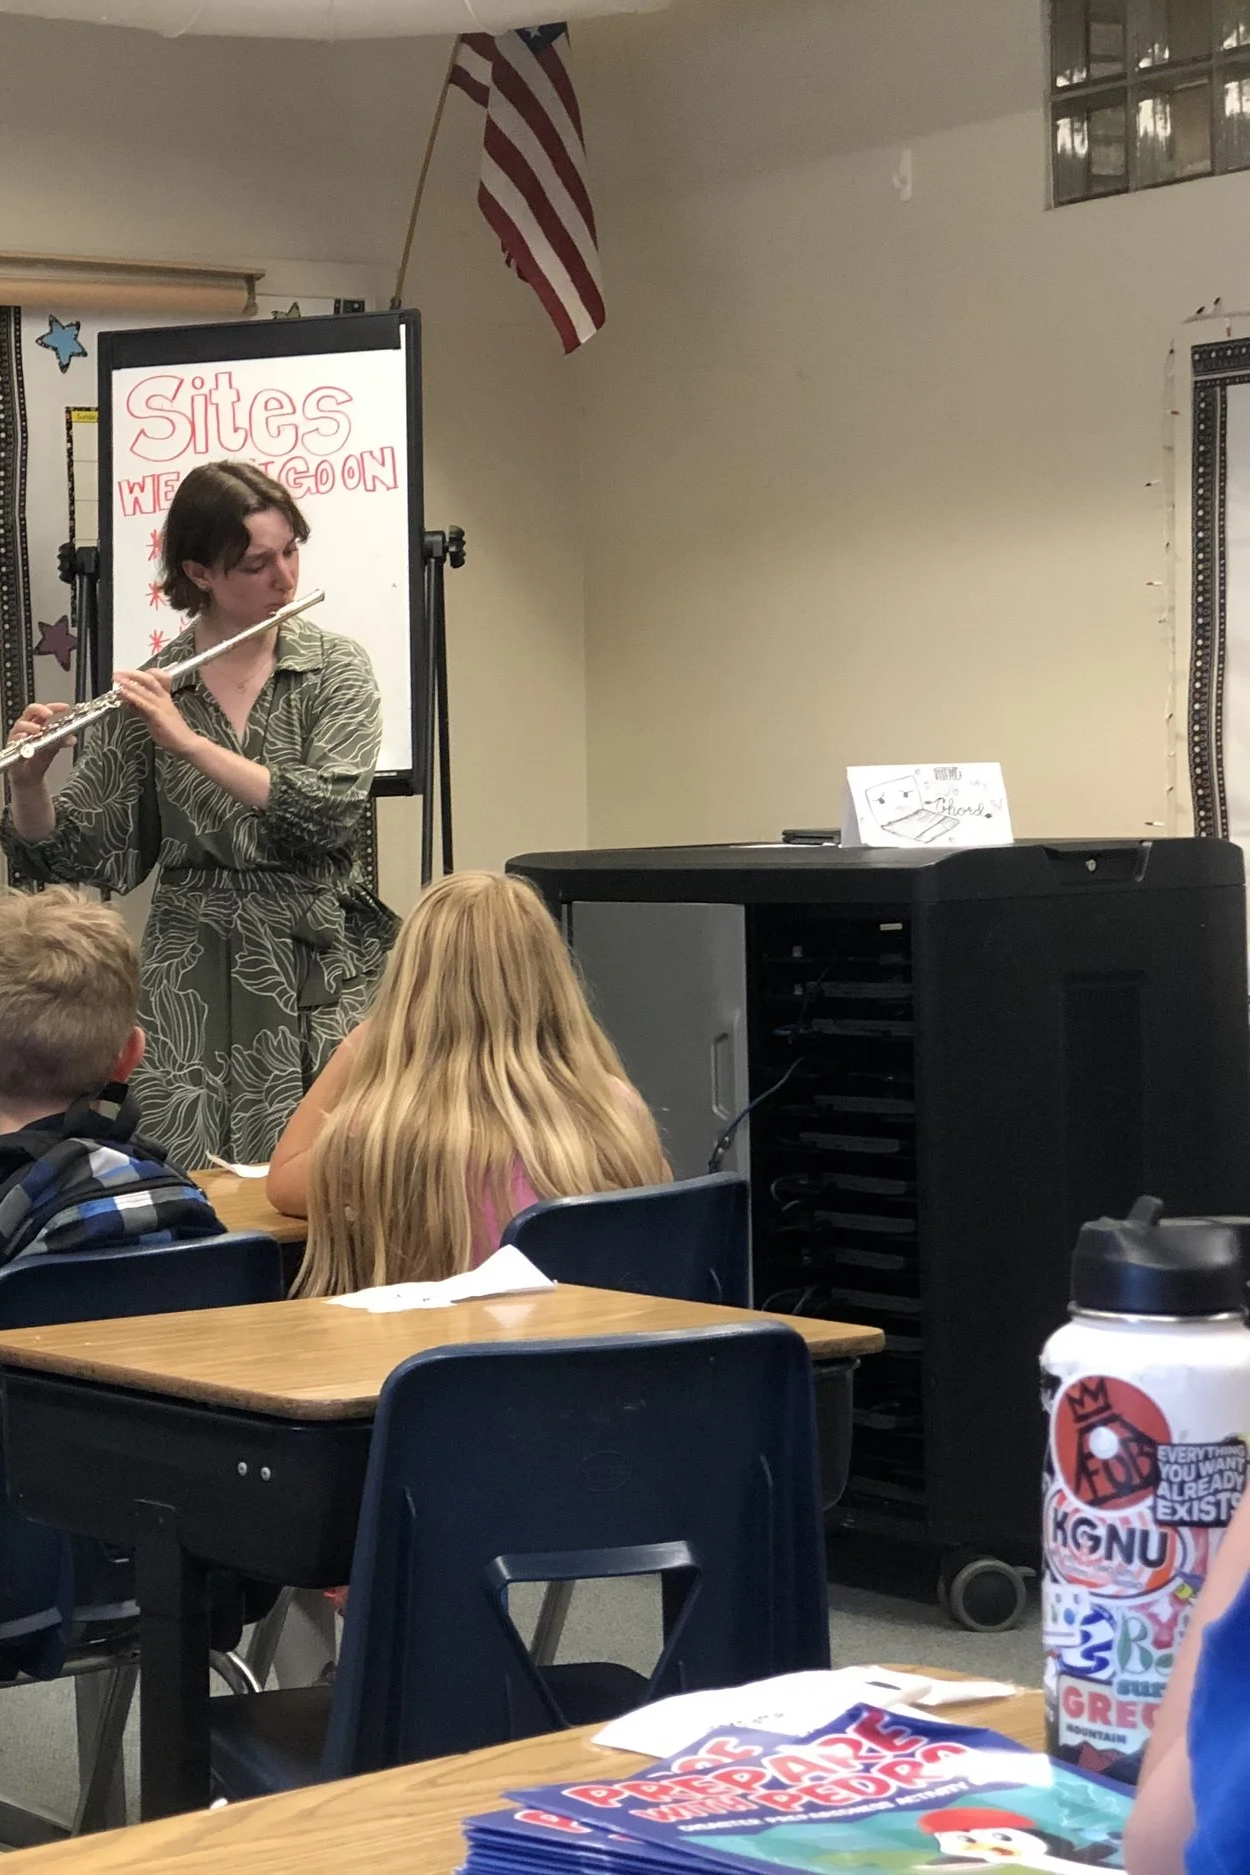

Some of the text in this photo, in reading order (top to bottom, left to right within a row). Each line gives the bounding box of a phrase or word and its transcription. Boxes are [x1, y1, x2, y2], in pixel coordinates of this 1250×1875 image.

[126, 371, 354, 462] Sites
[118, 471, 180, 517] WE
[277, 456, 336, 499] GO
[341, 446, 399, 492] ON
[1157, 1445, 1246, 1463] EVERYTHING
[1158, 1457, 1246, 1482] YOU WANT
[1156, 1470, 1245, 1501] ALREADY
[1052, 1506, 1169, 1569] KGNU
[561, 1703, 929, 1808] PREPARE
[1065, 1722, 1128, 1745] MOUNTAIN
